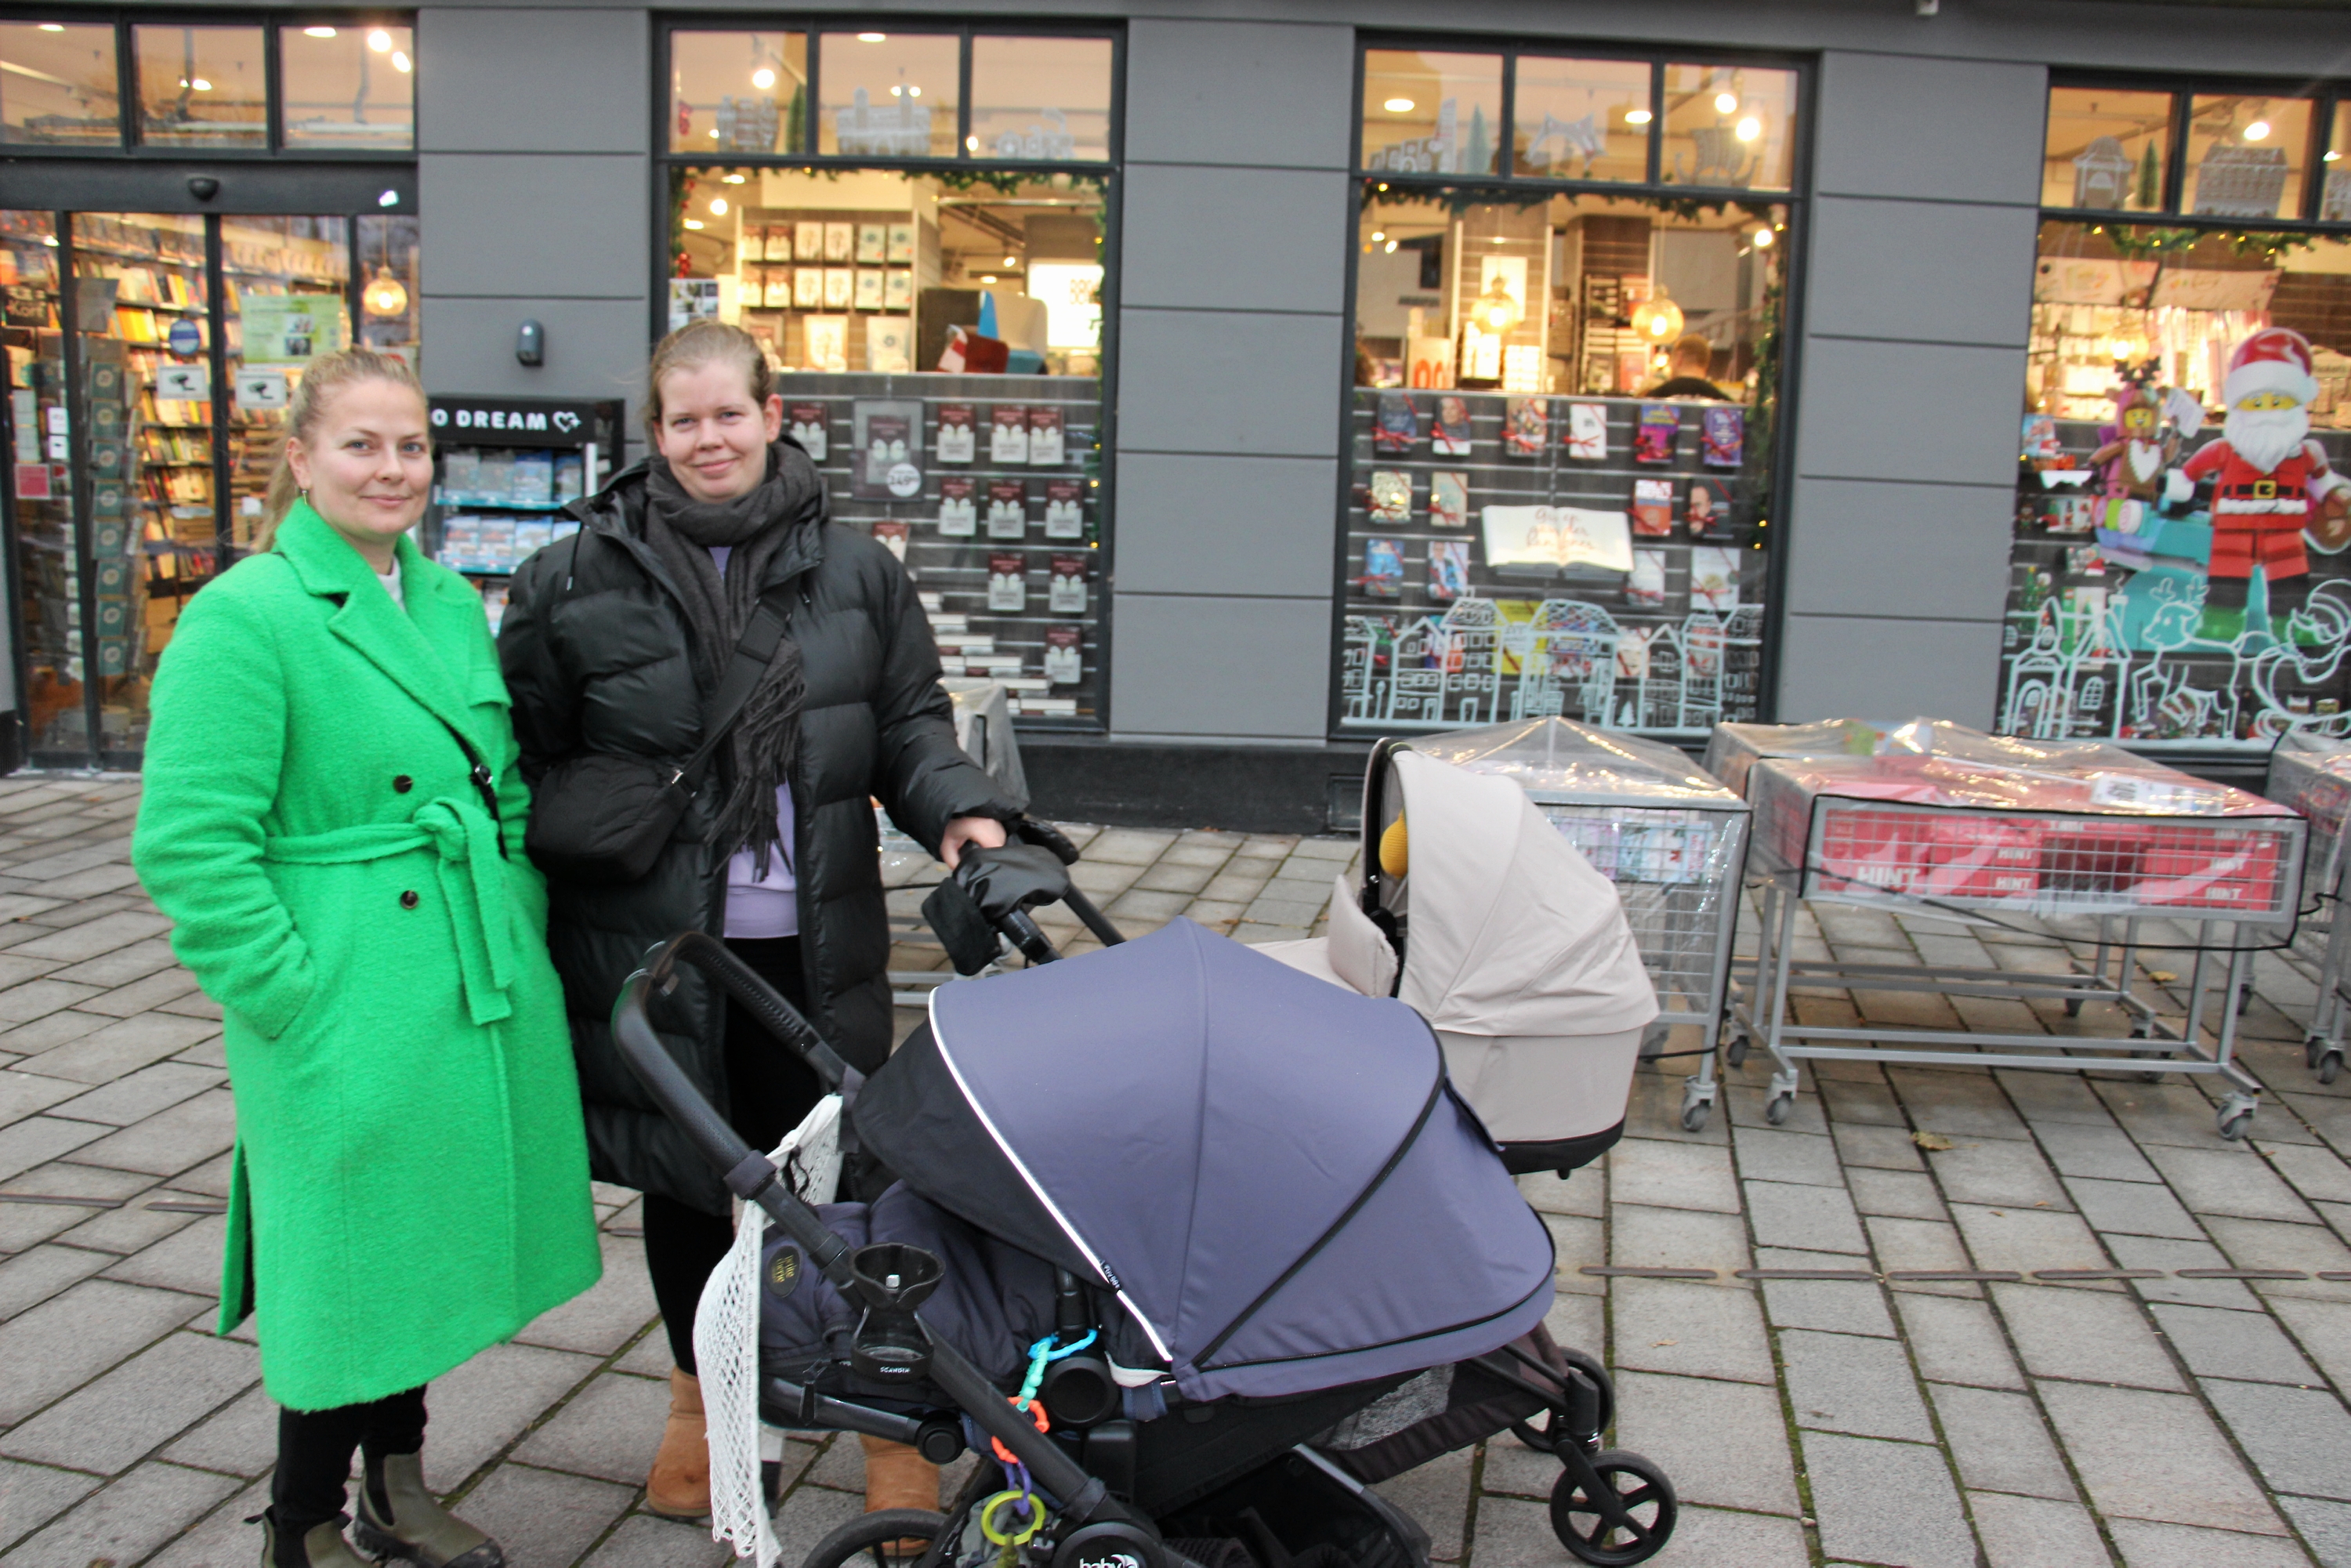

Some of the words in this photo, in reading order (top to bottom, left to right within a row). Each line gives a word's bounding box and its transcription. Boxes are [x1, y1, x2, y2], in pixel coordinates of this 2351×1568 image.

[455, 409, 548, 431] DREAM
[1998, 846, 2033, 860] HINT
[1857, 866, 1920, 889] HINT
[1996, 875, 2032, 890] HINT
